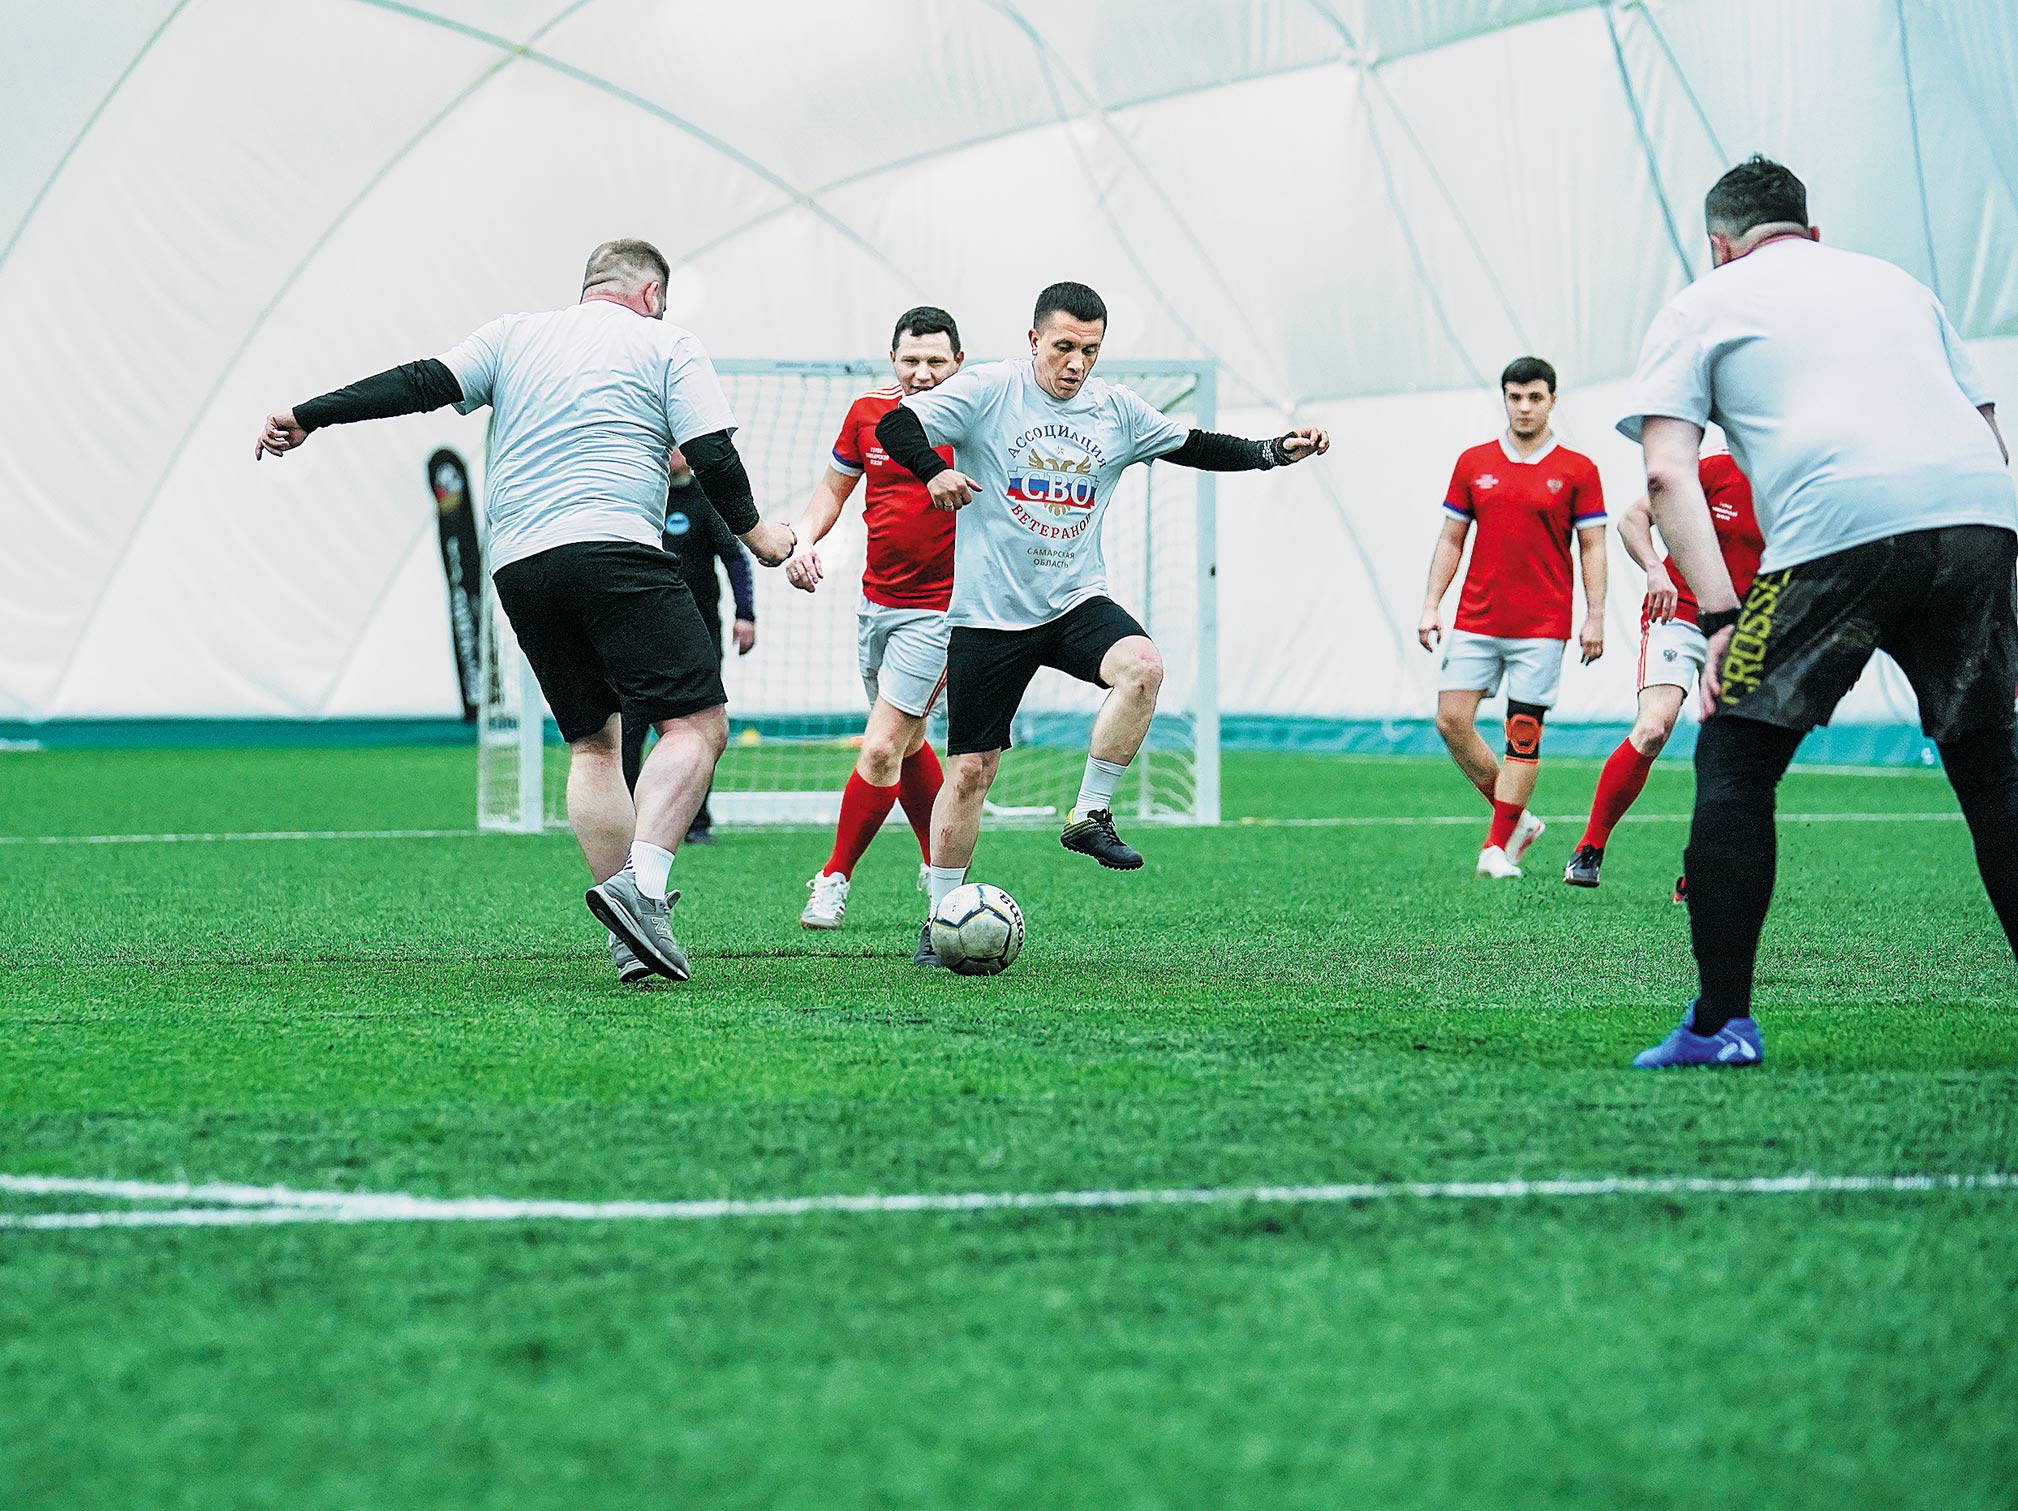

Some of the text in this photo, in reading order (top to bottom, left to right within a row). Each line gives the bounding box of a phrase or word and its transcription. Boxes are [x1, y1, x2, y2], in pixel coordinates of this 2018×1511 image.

[1008, 425, 1107, 468] АССОЦИАЦИЯ
[1021, 471, 1092, 505] СВО
[1027, 547, 1075, 559] САМАРСКАЯ
[1033, 558, 1069, 568] ОБЛАСТЬ
